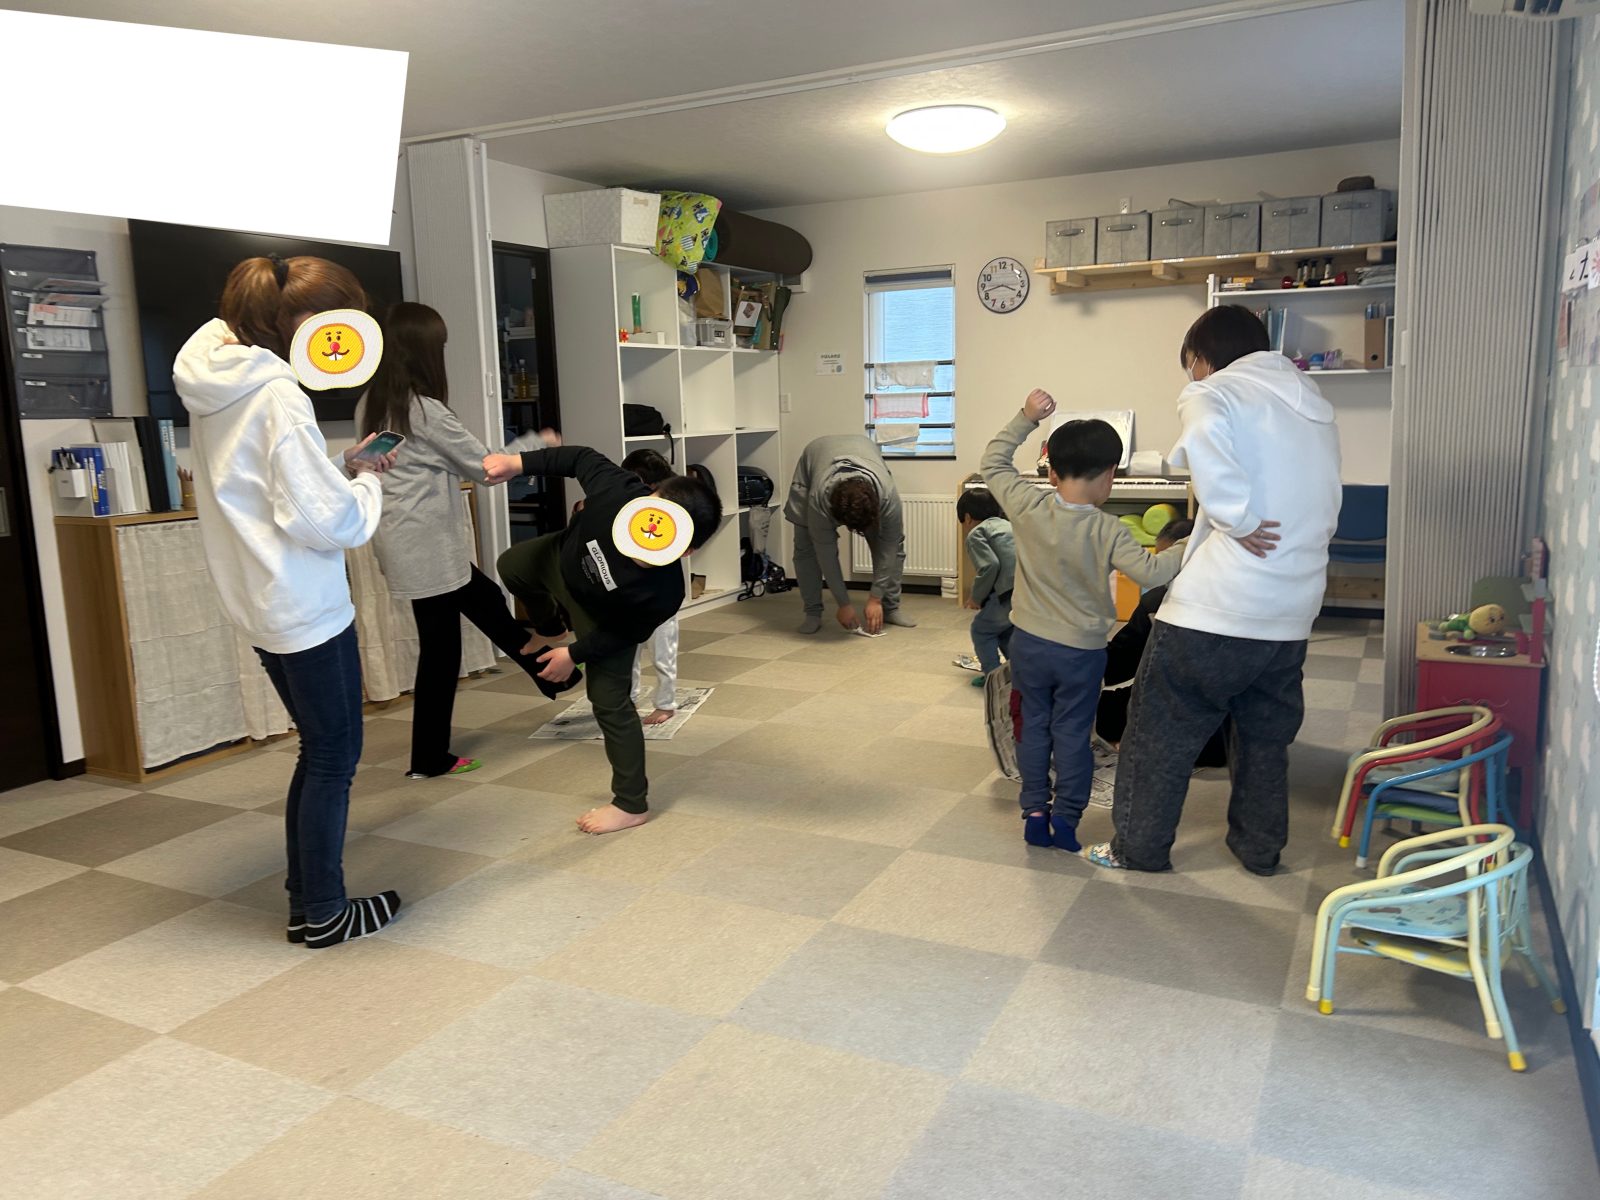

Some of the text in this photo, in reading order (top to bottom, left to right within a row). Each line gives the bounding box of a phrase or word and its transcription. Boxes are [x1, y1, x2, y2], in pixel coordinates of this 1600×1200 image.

[998, 262, 1006, 270] 12
[991, 299, 996, 307] 7
[592, 547, 610, 584] GLORIOUS
